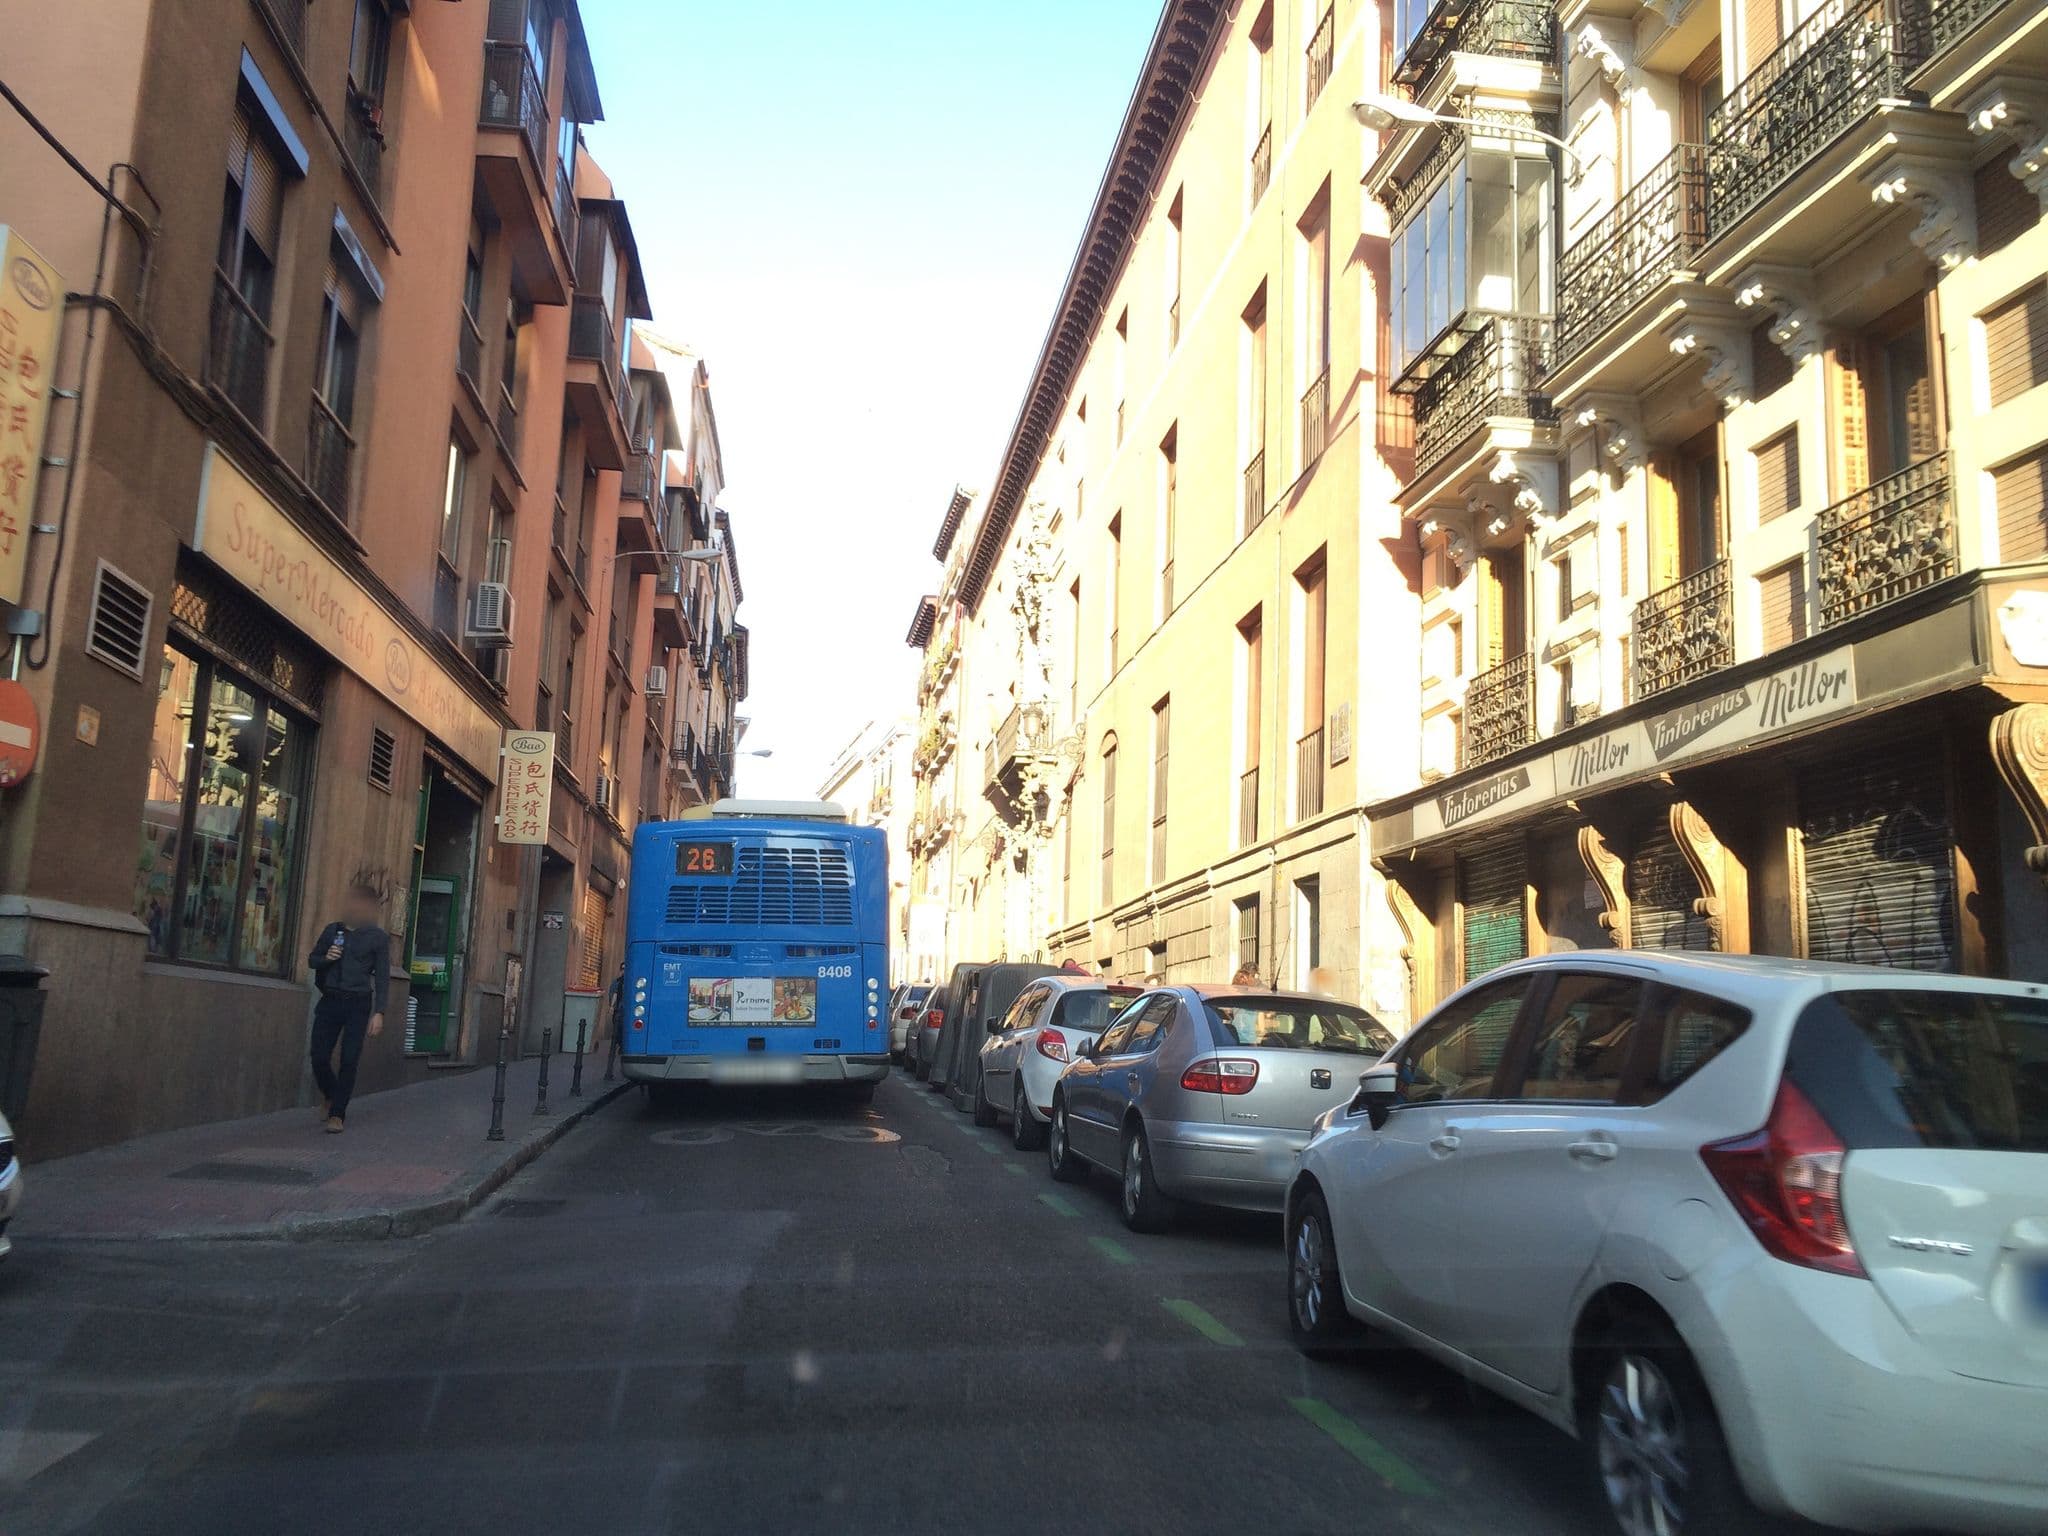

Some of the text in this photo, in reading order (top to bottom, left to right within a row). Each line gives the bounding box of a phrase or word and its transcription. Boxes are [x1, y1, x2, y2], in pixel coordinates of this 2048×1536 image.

[227, 502, 375, 659] SuperMercado
[1654, 661, 1848, 752] Tintorerias Millor
[515, 739, 542, 751] Bao
[503, 758, 522, 839] SUPERMERCADO
[1444, 734, 1630, 826] Tintorerias Millor
[686, 846, 715, 871] 26
[663, 963, 682, 972] EMT
[817, 965, 852, 979] 8408
